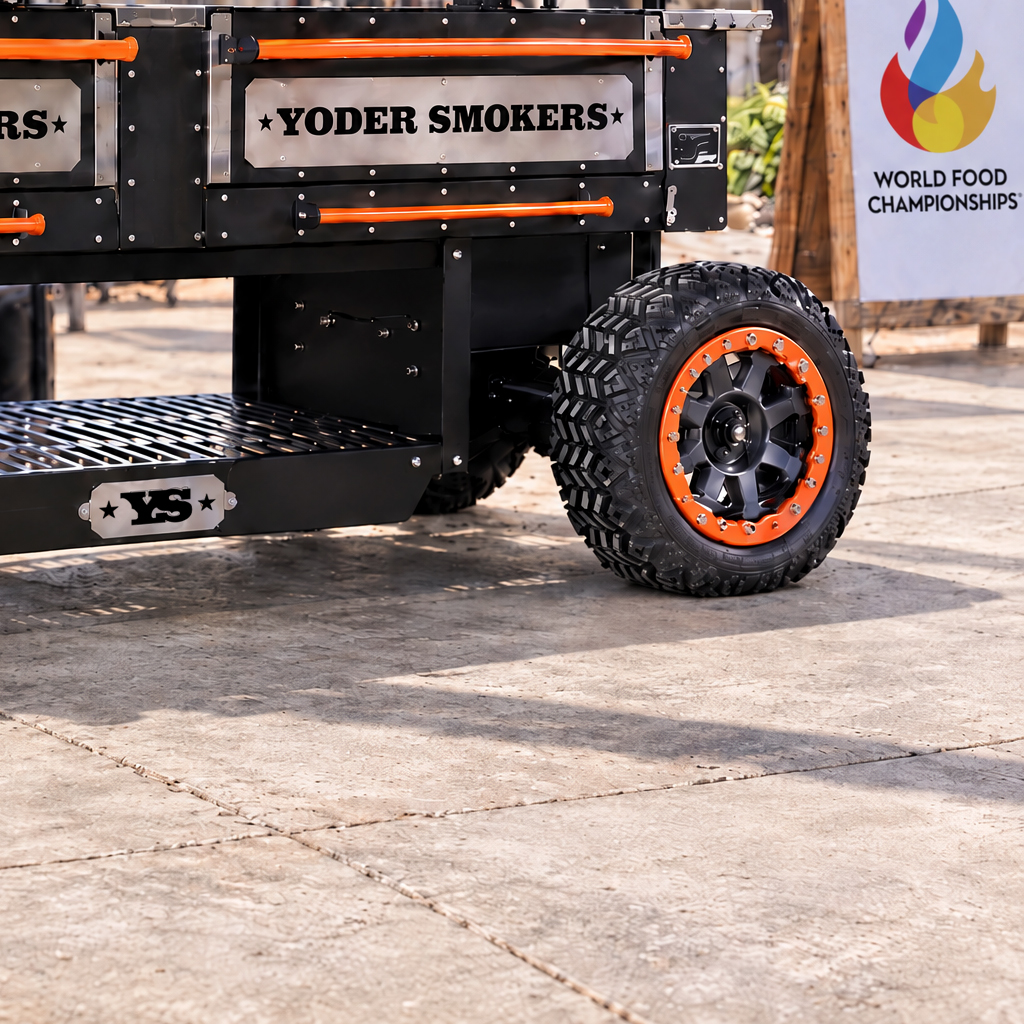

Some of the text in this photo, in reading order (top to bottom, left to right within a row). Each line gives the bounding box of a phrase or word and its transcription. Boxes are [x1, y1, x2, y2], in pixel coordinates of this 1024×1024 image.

[276, 103, 608, 136] YODER SMOKERS
[873, 168, 1008, 189] WORLD FOOD
[120, 488, 193, 526] YS
